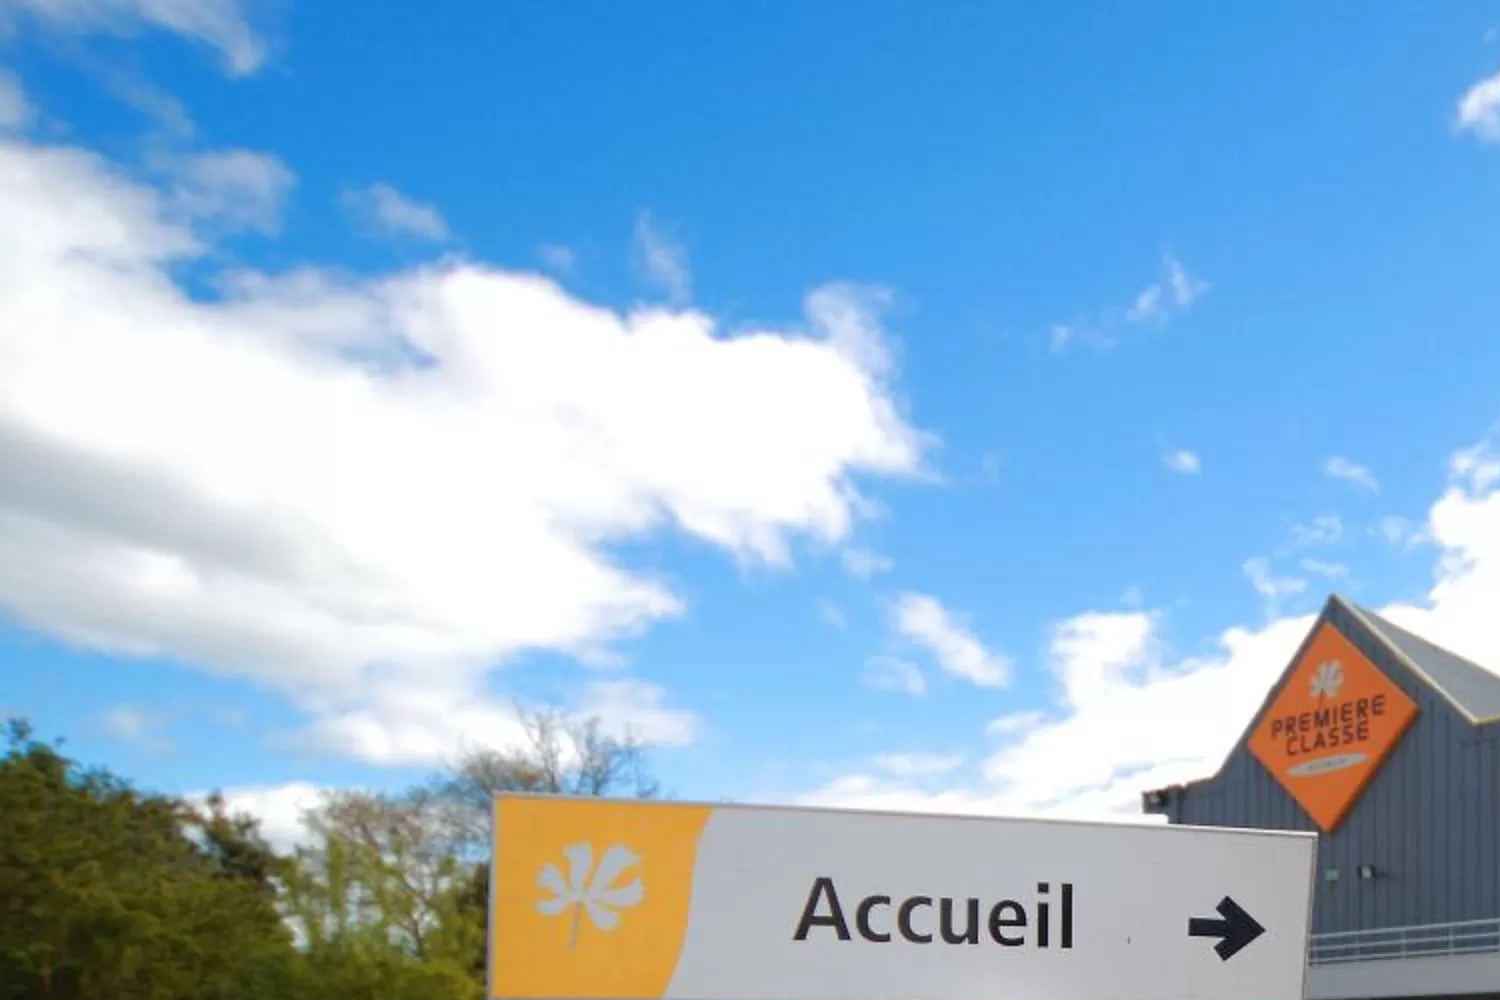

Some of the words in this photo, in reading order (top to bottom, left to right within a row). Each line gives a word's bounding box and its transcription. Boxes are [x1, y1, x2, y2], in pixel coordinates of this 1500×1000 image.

[1270, 694, 1385, 738] PREMIERE
[1286, 721, 1369, 756] CLASSE
[792, 876, 1074, 949] Accueil
